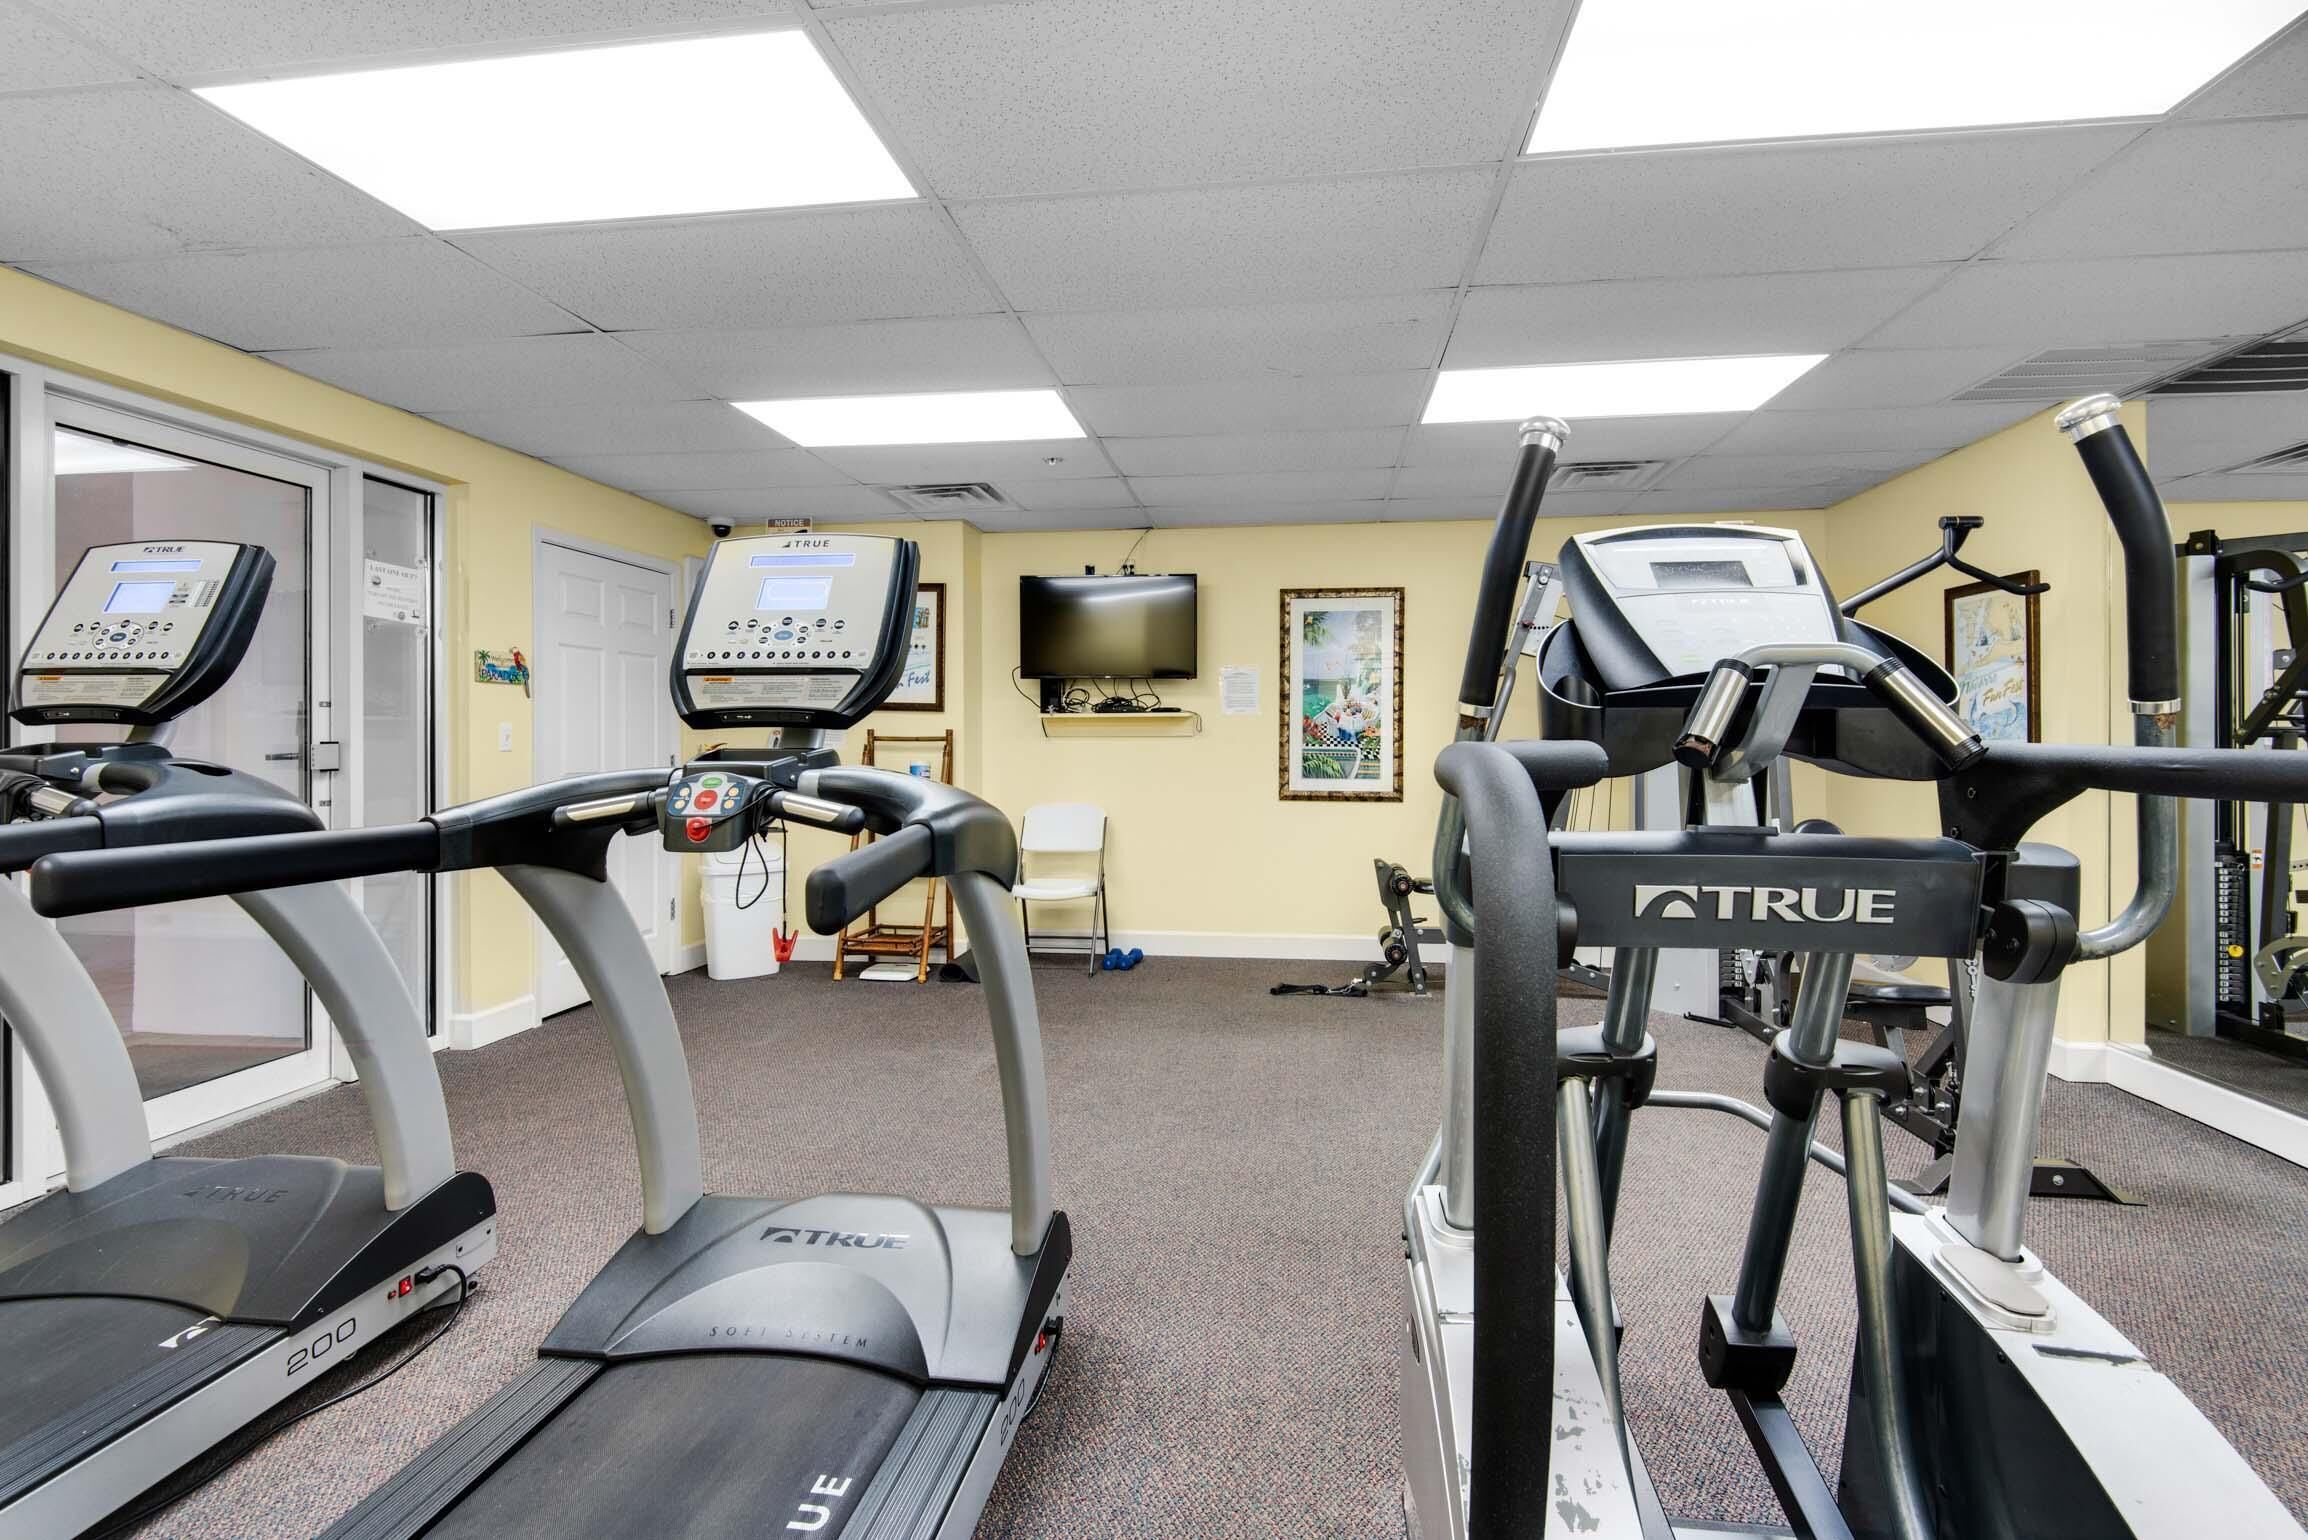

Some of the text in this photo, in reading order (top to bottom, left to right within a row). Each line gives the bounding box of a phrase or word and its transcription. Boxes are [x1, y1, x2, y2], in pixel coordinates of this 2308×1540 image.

[774, 519, 805, 527] NOTICE
[794, 539, 830, 548] TRUE
[1701, 885, 1897, 924] TRUE
[205, 1186, 289, 1203] TRUE
[804, 1229, 911, 1250] TRUE
[287, 1317, 357, 1377] 200
[1000, 1377, 1025, 1447] 200
